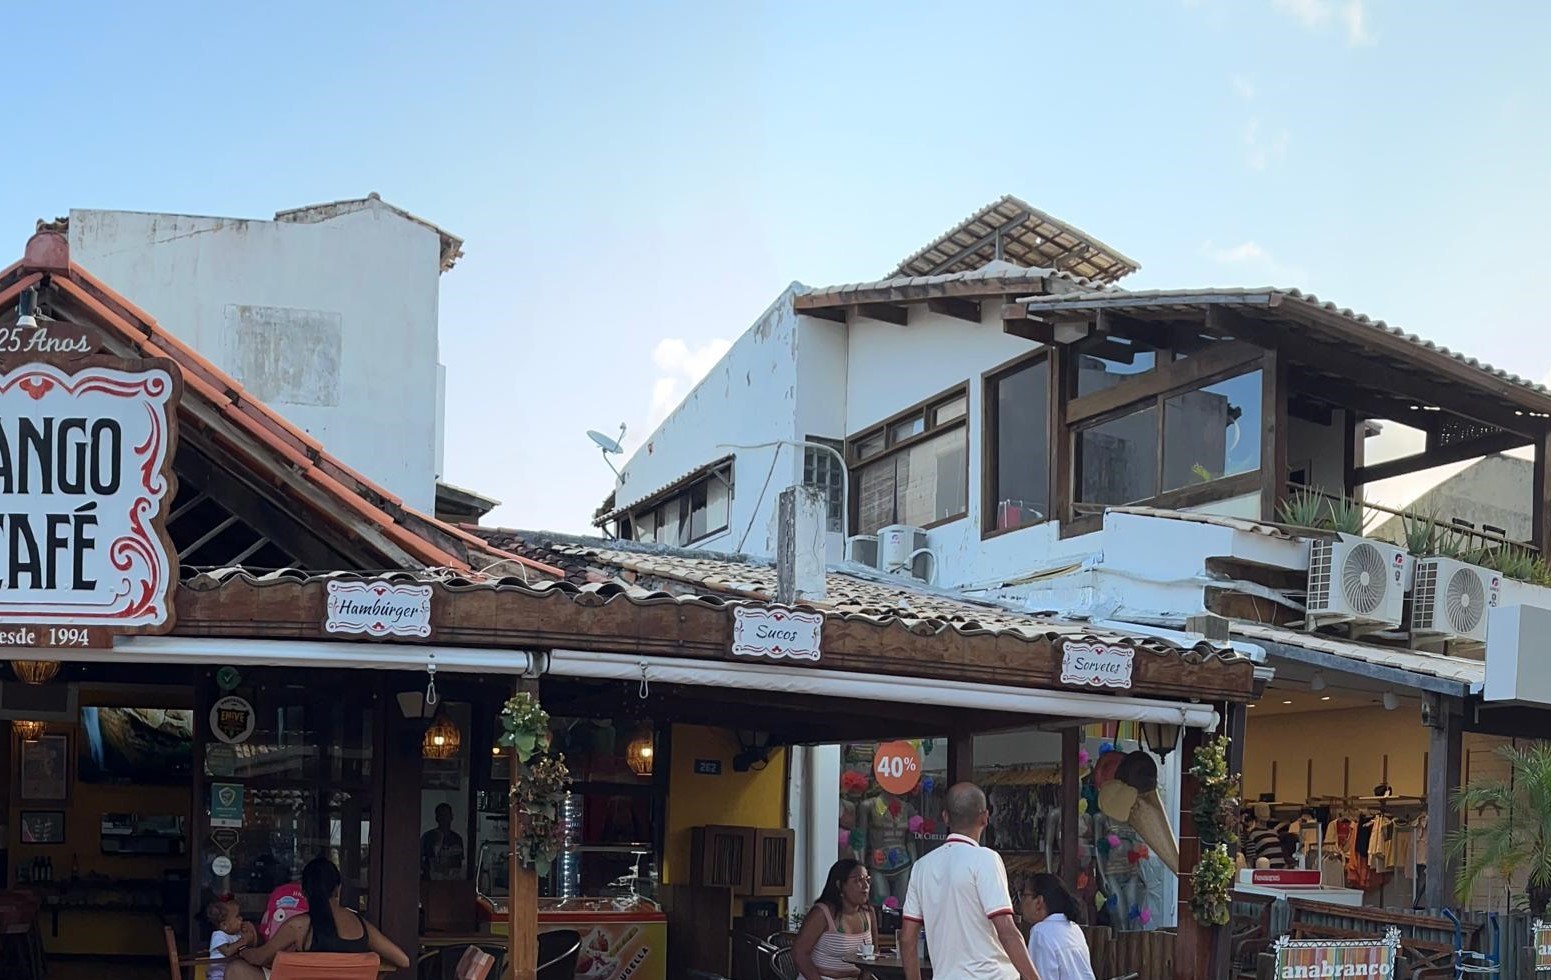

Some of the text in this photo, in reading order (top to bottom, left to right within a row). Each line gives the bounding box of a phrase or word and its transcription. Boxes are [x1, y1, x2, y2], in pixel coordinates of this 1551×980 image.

[23, 327, 92, 352] Anos
[49, 627, 89, 646] 1994
[755, 624, 798, 642] Sucos
[1074, 656, 1121, 674] Sorvetes
[877, 755, 916, 778] 40%
[1281, 960, 1390, 979] anabranco
